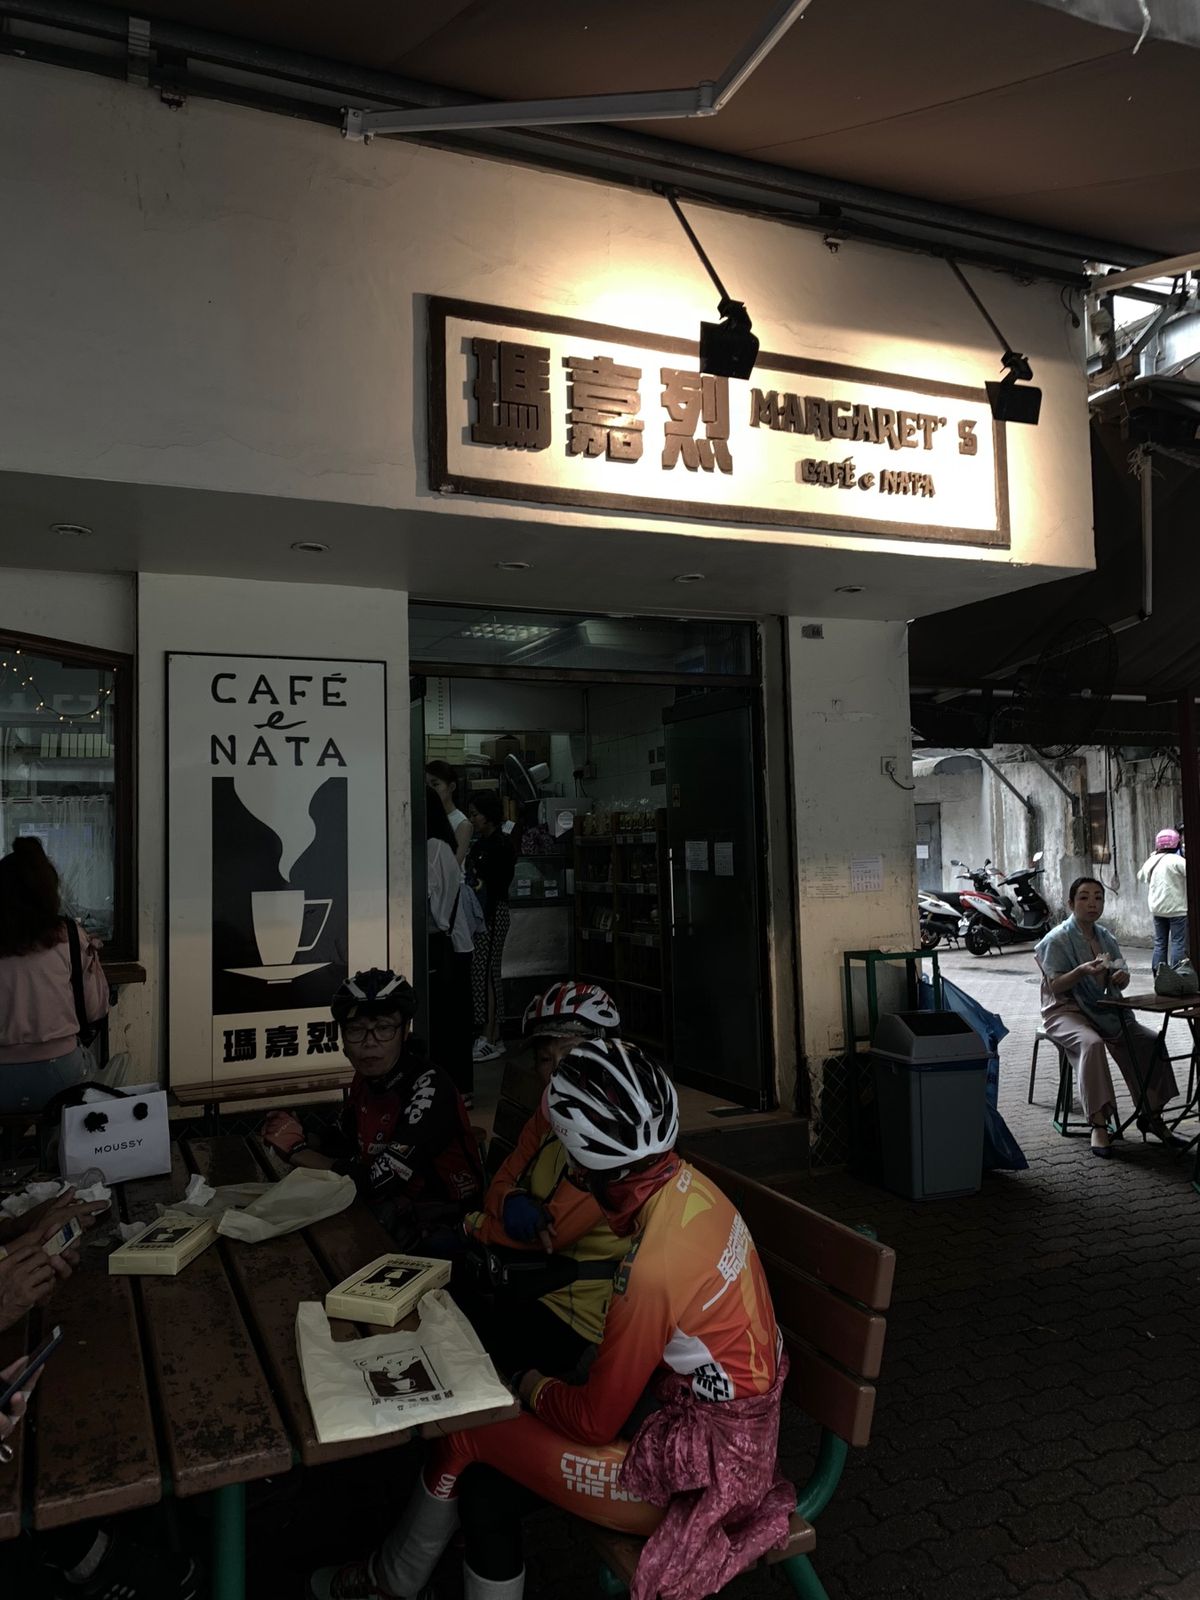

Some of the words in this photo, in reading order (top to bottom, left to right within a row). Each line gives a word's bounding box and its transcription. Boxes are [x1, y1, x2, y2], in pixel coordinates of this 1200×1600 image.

[470, 337, 734, 475] 瑪嘉烈
[801, 456, 857, 489] CAFÉ
[879, 469, 936, 498] NATA
[211, 672, 347, 706] CAFÉ
[253, 710, 307, 730] e
[210, 734, 347, 766] NATA
[222, 1020, 340, 1063] 瑪嘉烈
[94, 1138, 143, 1155] MOUSSY
[562, 1473, 605, 1499] THE
